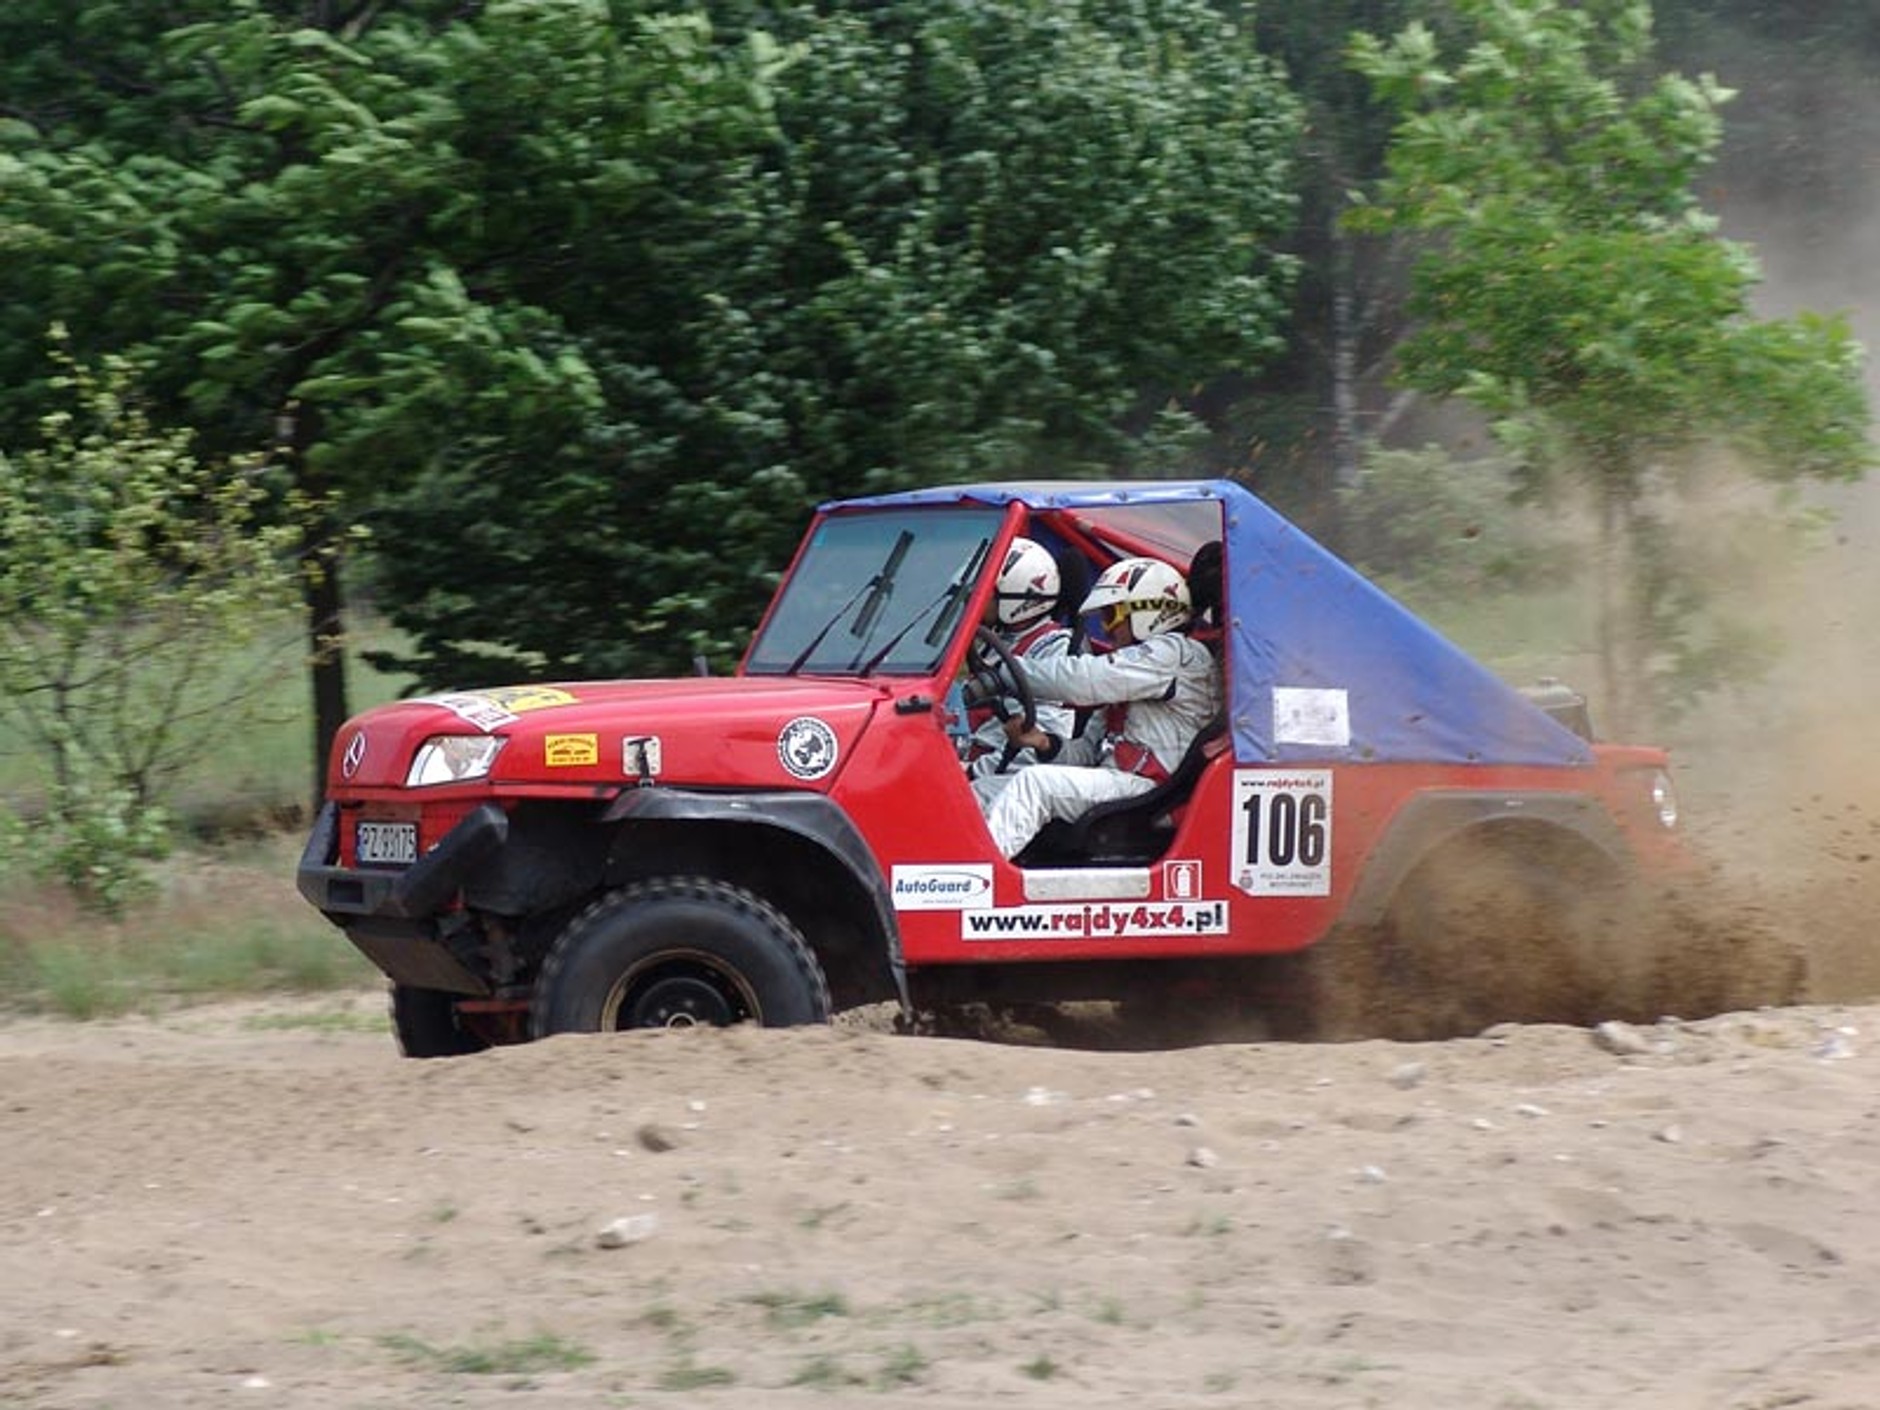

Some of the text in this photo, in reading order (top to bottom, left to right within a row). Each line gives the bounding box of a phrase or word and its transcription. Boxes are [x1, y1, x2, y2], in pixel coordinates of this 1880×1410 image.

[1243, 792, 1327, 867] 106
[895, 878, 972, 894] AutoGuard
[969, 903, 1223, 937] www.rajdy4x4.pl
